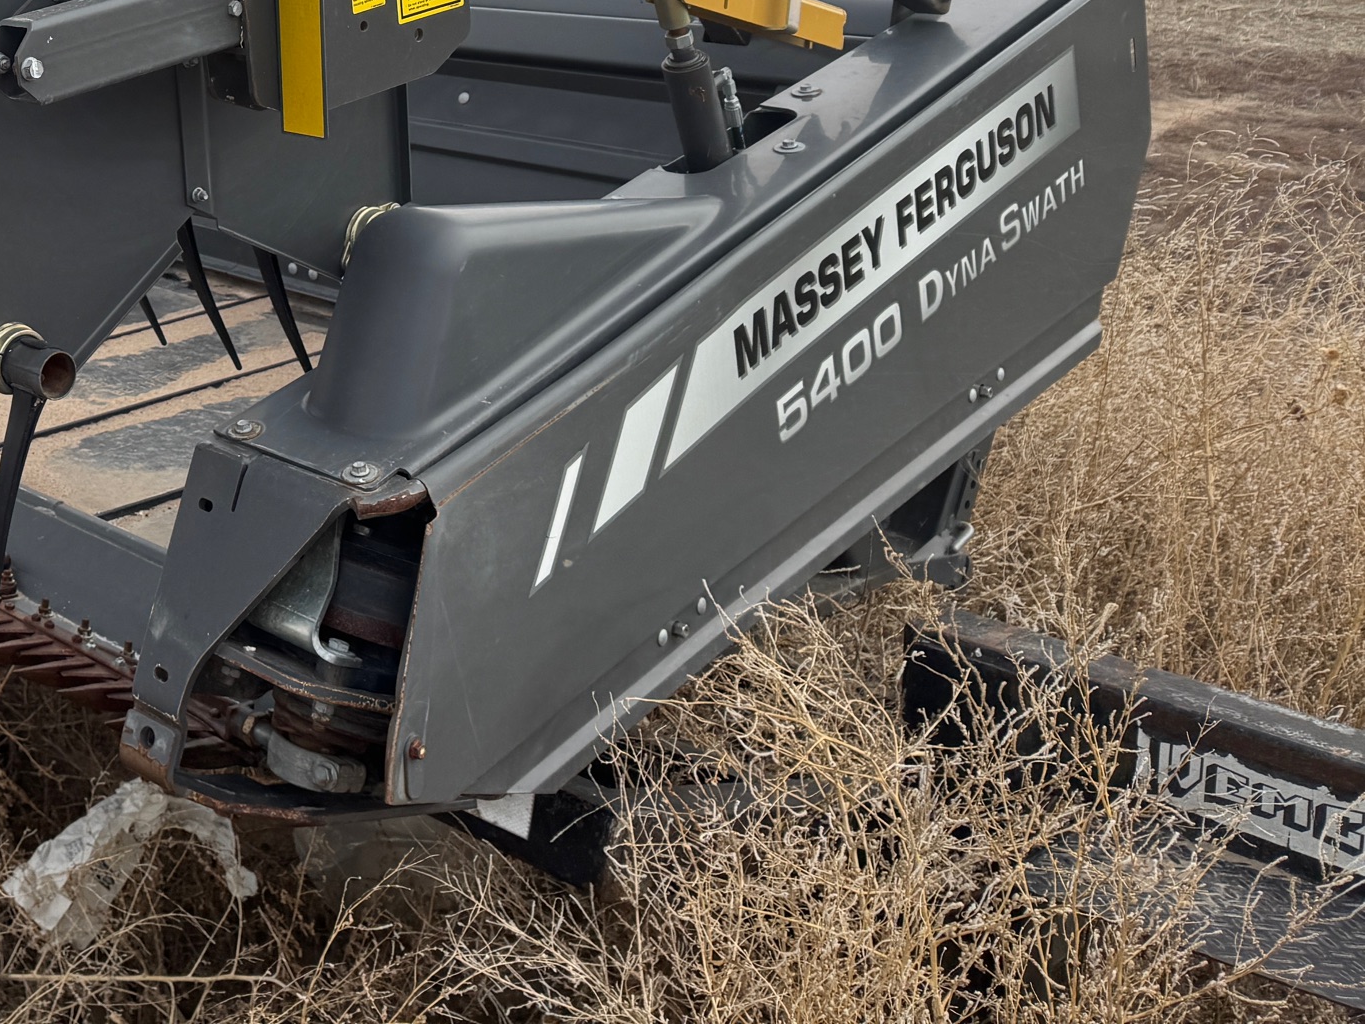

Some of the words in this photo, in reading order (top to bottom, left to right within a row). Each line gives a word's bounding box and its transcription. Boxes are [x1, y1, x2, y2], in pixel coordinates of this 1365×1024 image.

[733, 214, 885, 380] MASSEY
[895, 83, 1057, 250] FERGUSON
[776, 302, 903, 443] 5400
